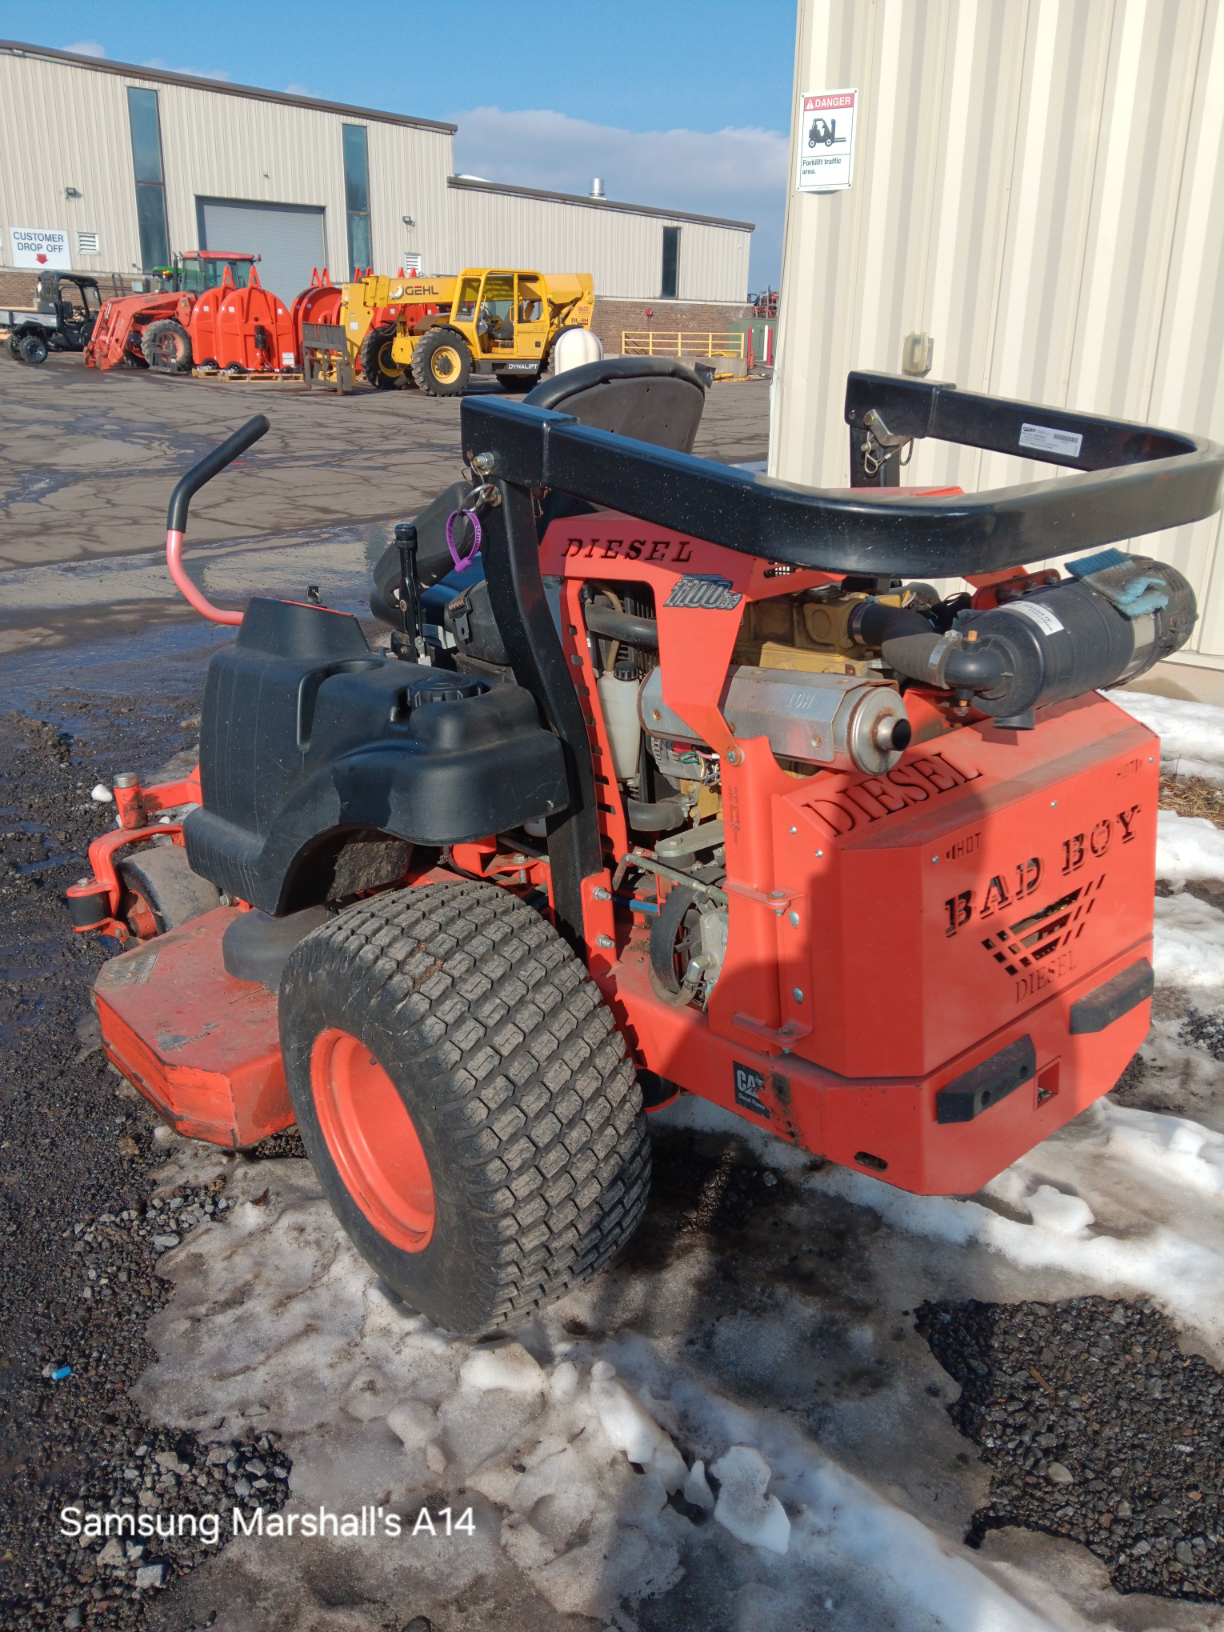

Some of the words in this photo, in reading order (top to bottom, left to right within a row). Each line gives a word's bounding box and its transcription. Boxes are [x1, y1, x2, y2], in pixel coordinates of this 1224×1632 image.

[815, 96, 851, 108] DANGER
[802, 158, 823, 167] Forklift
[824, 157, 842, 165] traffic
[13, 231, 64, 243] CUSTOMER
[17, 242, 43, 252] DROP
[46, 243, 64, 253] OFF
[405, 285, 439, 296] GEHL
[561, 538, 693, 563] DIESEL
[801, 752, 984, 838] DIESEL
[956, 832, 982, 859] HOT
[944, 856, 1045, 938] BAD
[1061, 803, 1142, 877] BOY
[1015, 949, 1078, 1004] DIESEL
[738, 1092, 752, 1104] Diesel
[751, 1098, 766, 1111] Power
